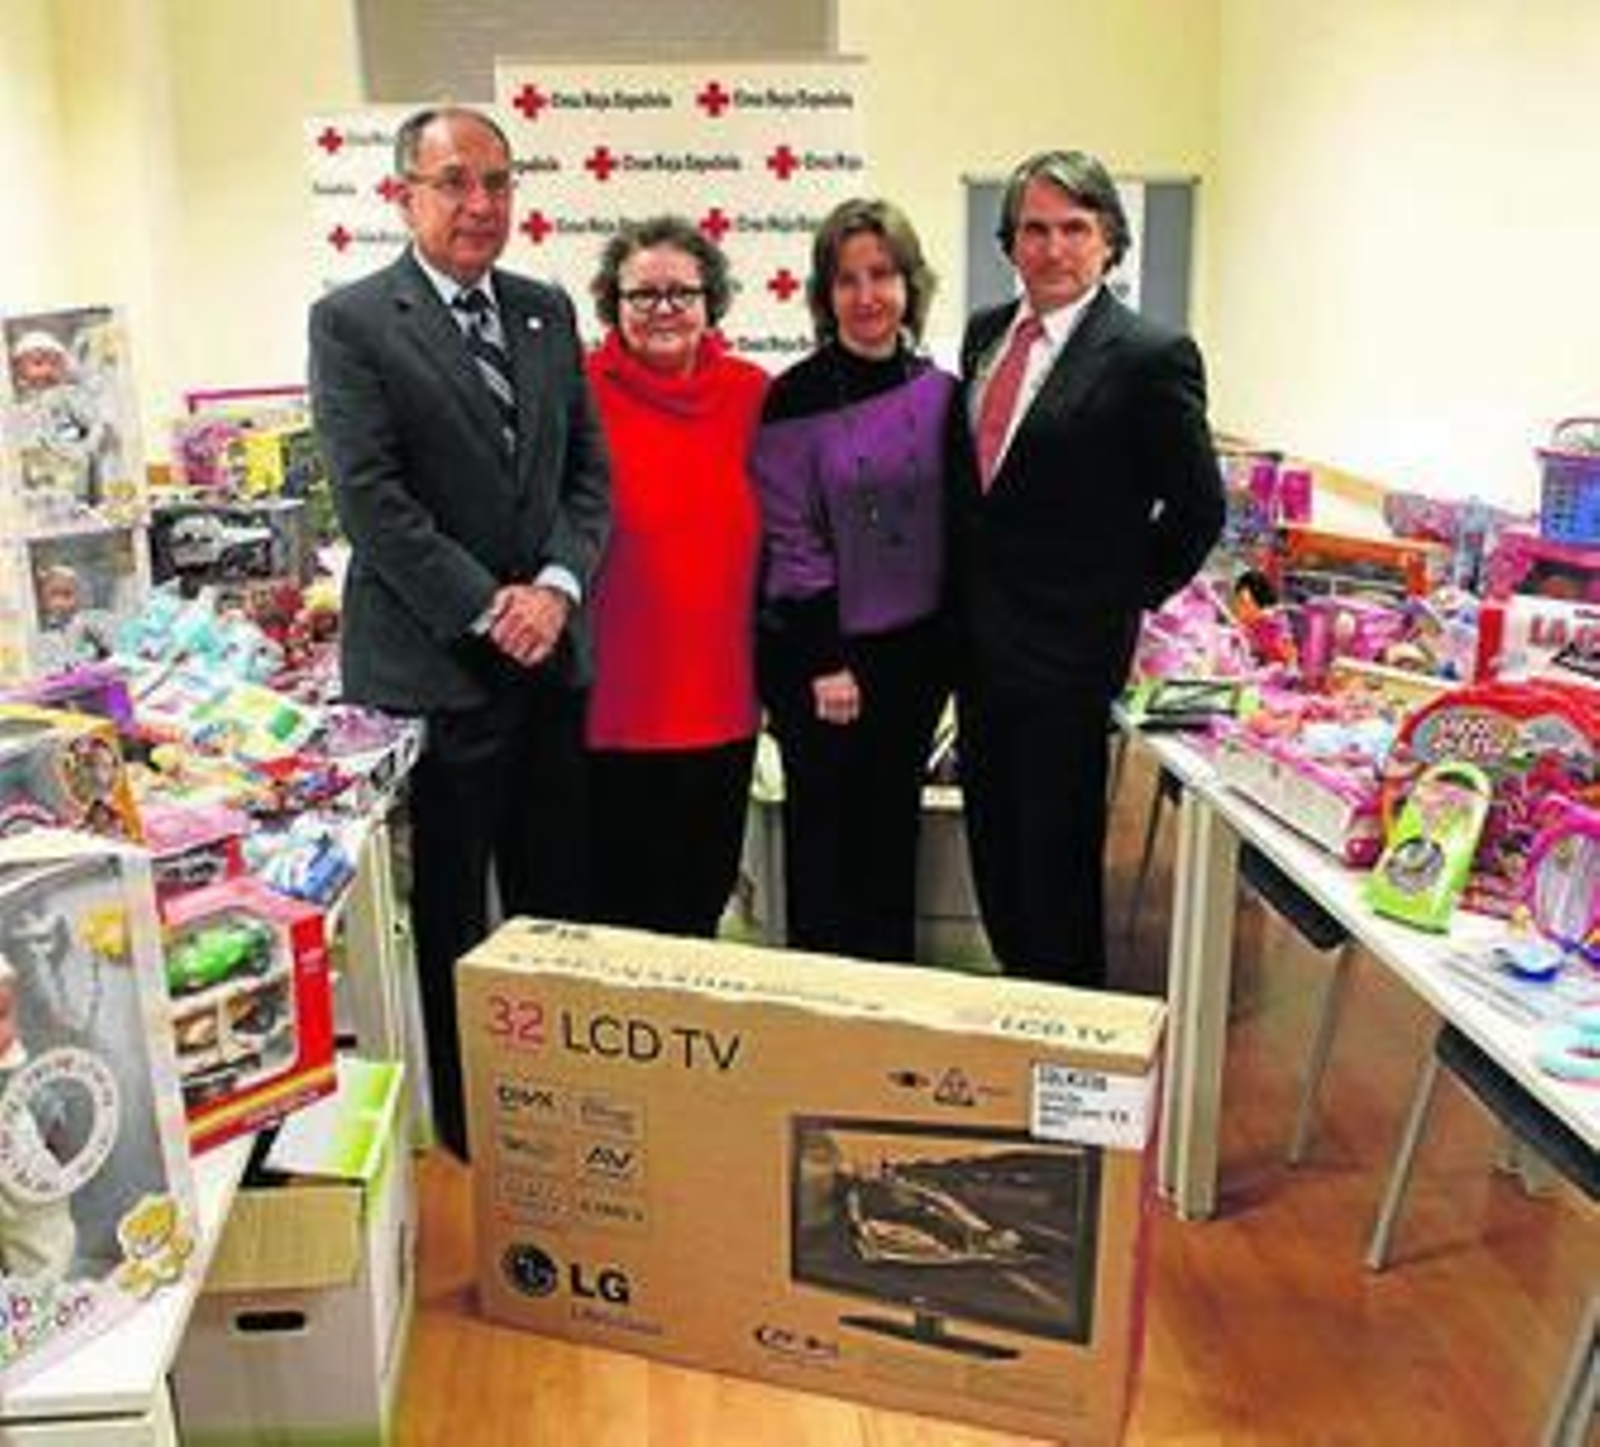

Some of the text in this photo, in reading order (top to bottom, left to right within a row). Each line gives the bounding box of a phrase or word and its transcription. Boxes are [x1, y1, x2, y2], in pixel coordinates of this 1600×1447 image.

[623, 153, 741, 174] Cruz Roja Española
[488, 995, 742, 1071] 32 LCD TV
[570, 1263, 631, 1306] LG
